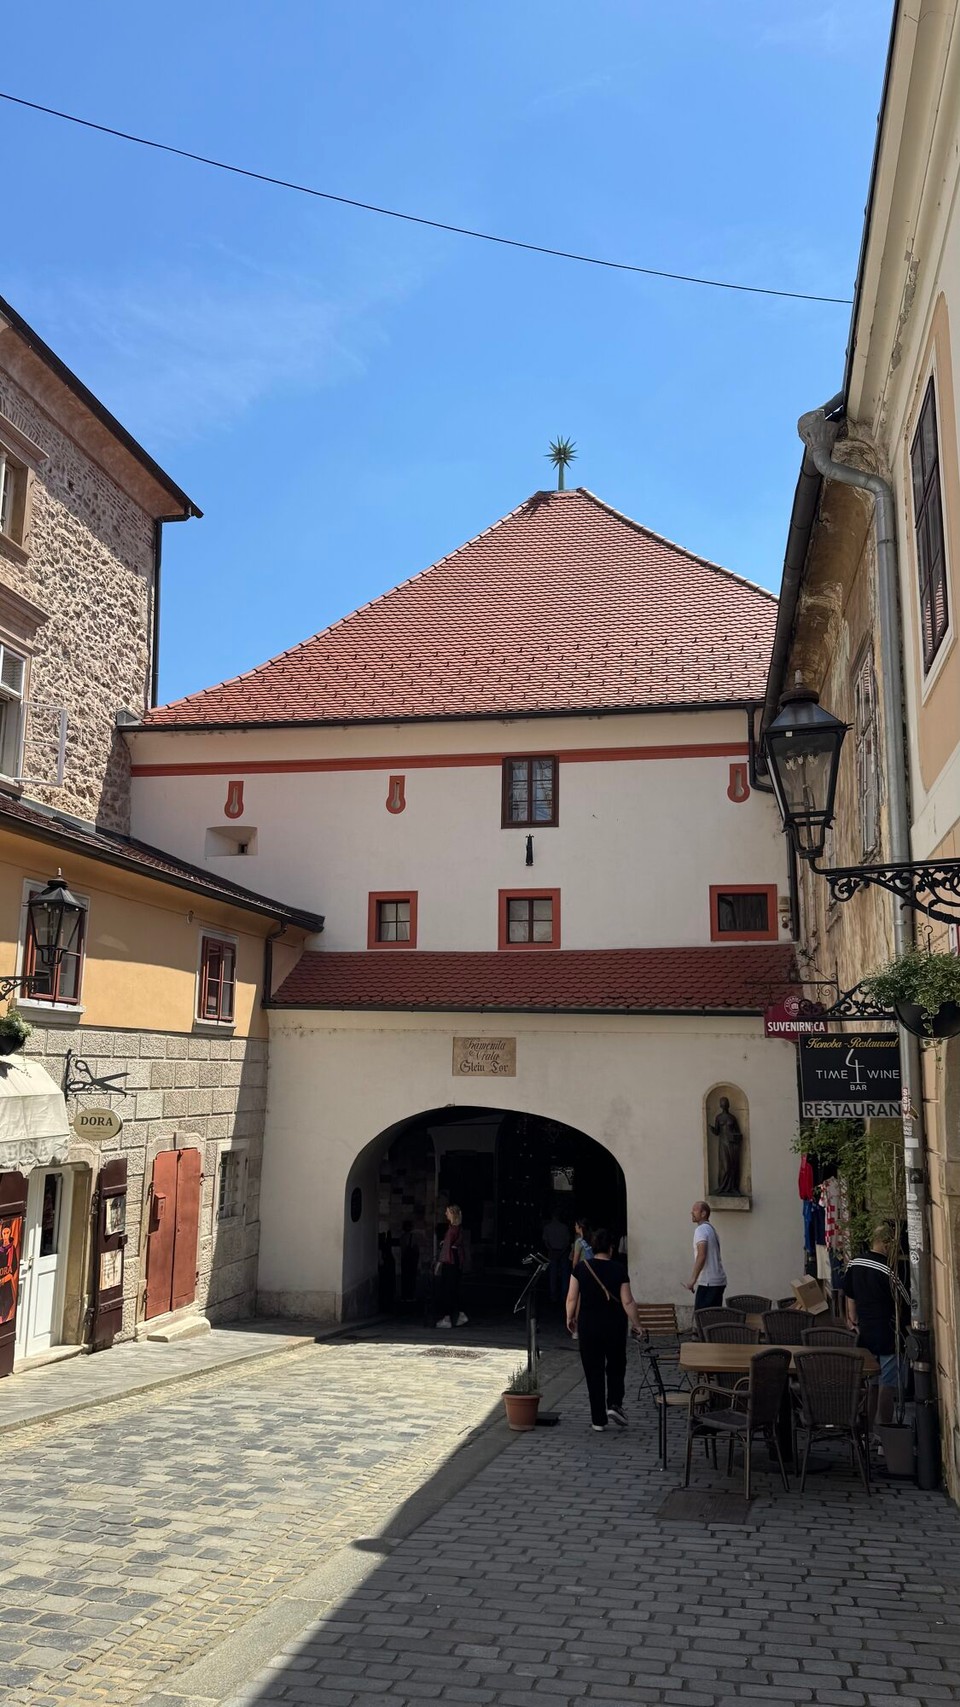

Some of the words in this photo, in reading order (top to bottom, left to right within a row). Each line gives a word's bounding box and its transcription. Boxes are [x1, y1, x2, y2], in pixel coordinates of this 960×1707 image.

[816, 1069, 848, 1079] TIME
[867, 1069, 900, 1079] WINE
[804, 1103, 901, 1117] RESTAURAN
[80, 1116, 113, 1126] DORA
